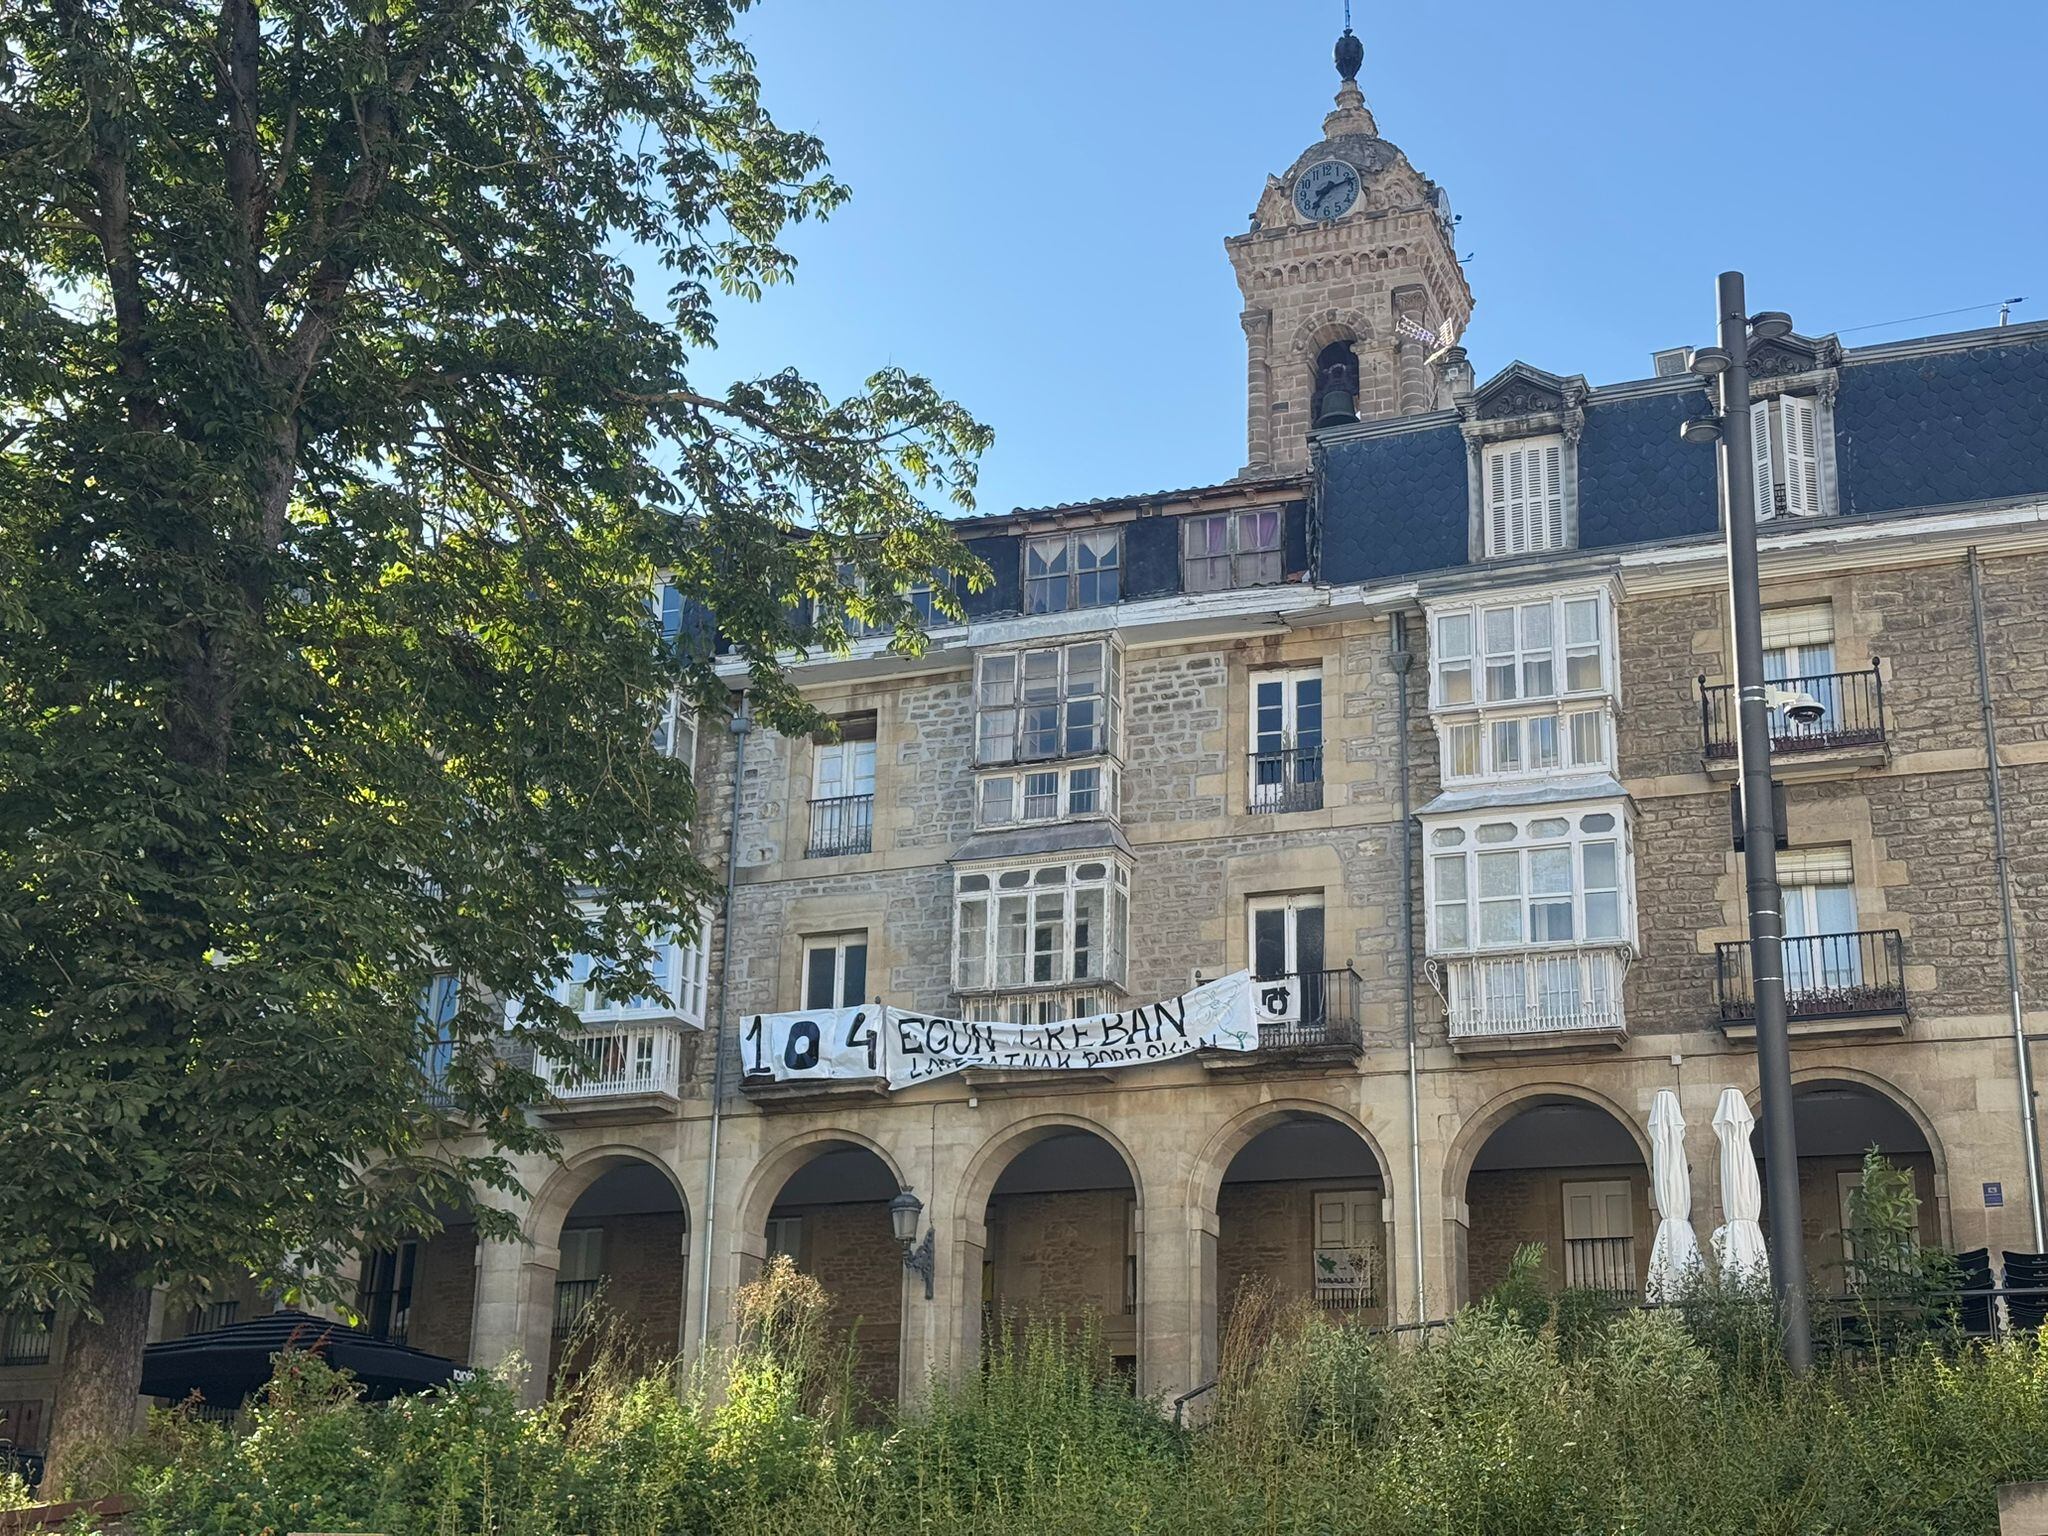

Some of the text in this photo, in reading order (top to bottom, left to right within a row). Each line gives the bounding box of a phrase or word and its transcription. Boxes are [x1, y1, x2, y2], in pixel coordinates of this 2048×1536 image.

[1313, 171, 1319, 181] 11
[1322, 165, 1332, 177] 12
[1336, 167, 1339, 177] 1
[1301, 179, 1311, 189] 10
[1347, 181, 1354, 192] 3
[1300, 190, 1307, 201] 9
[1343, 193, 1350, 202] 4
[1304, 200, 1311, 210] 8
[1334, 202, 1341, 212] 5
[1323, 206, 1330, 216] 6
[898, 1017, 996, 1055] EGUN
